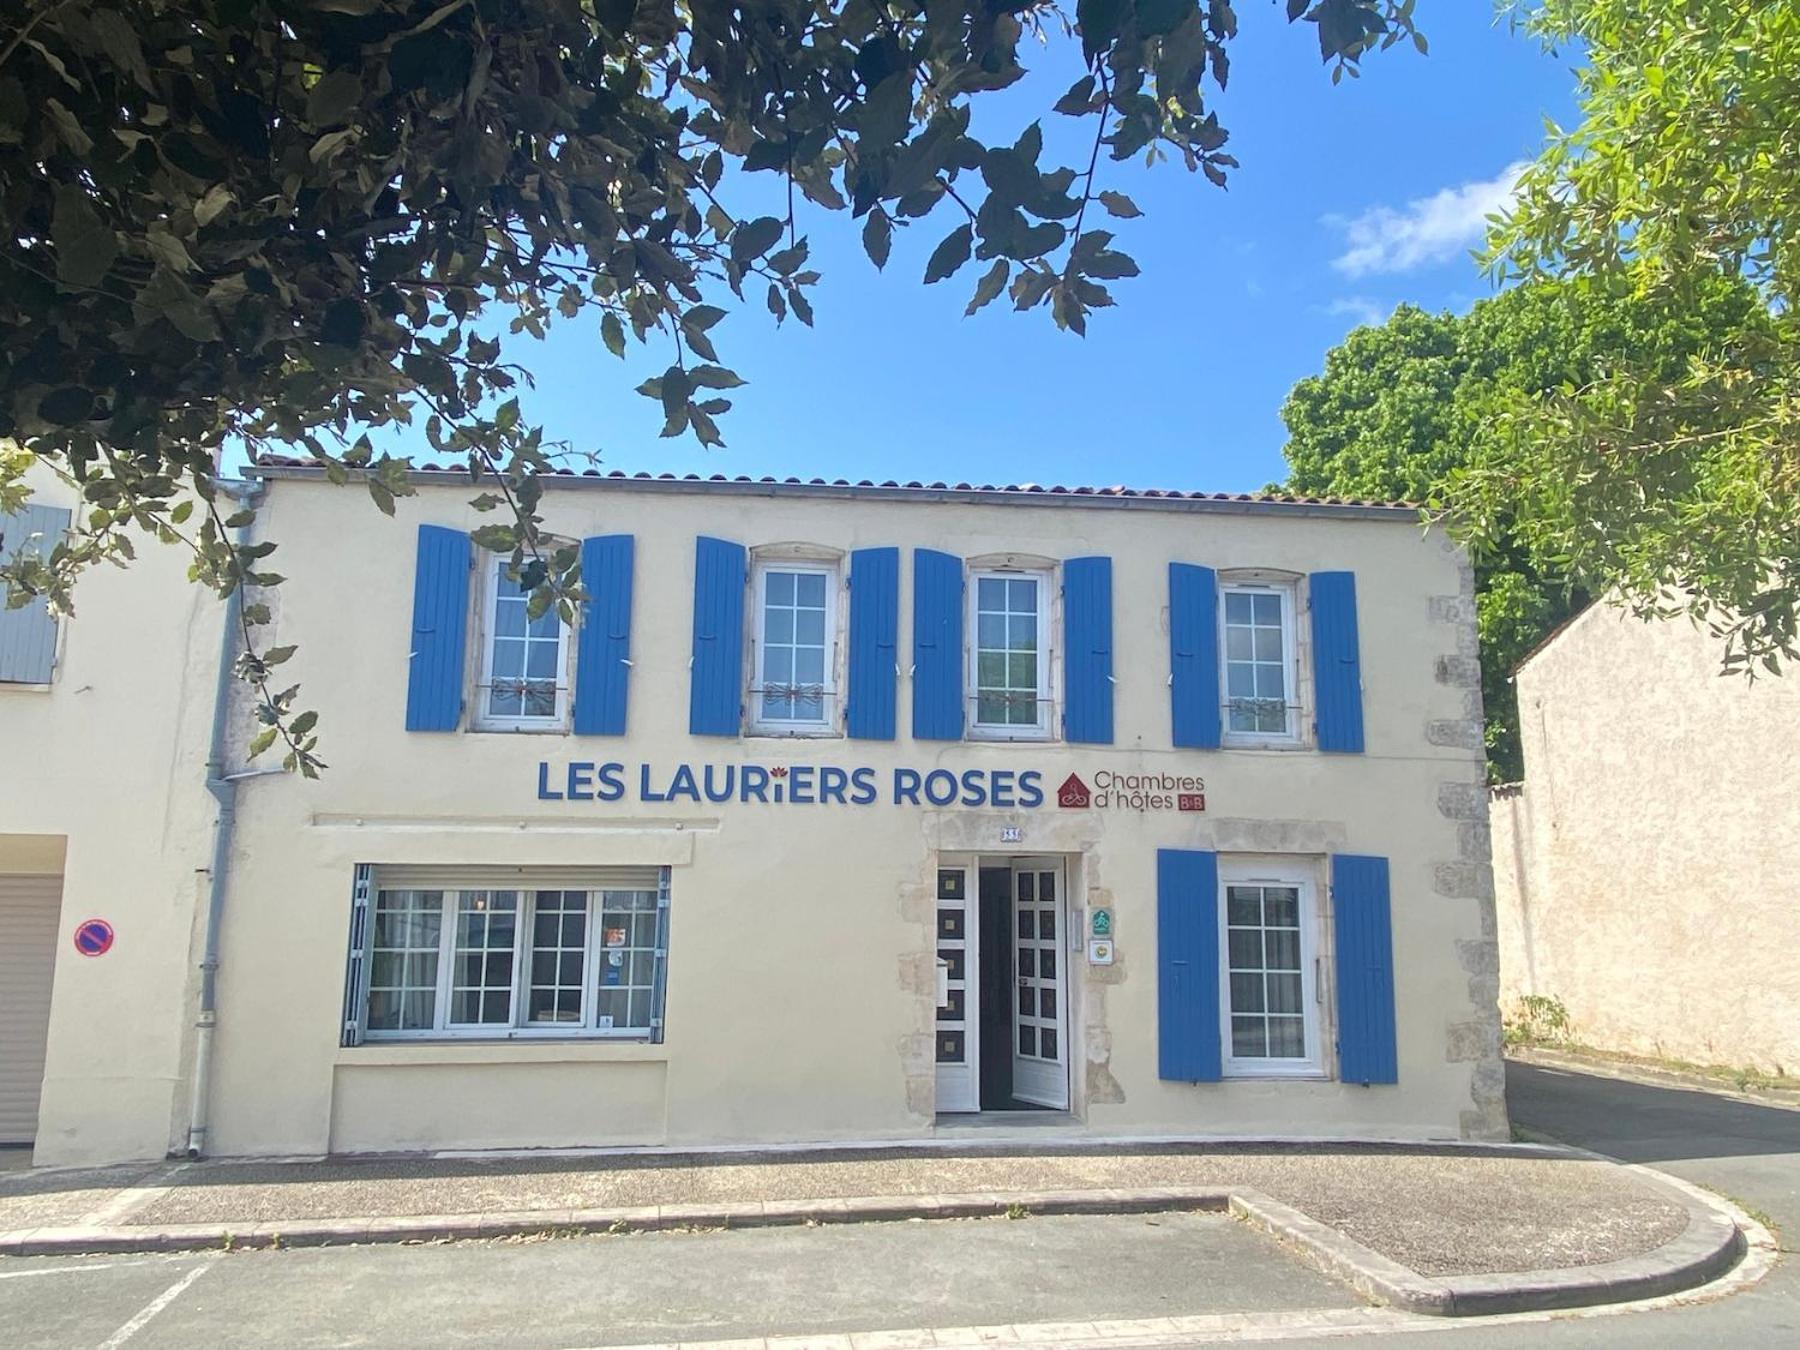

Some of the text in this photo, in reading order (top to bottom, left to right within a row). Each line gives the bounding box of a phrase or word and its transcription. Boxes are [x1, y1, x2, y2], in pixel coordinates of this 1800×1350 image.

[538, 762, 625, 800] LES
[894, 768, 1044, 808] ROSES
[1094, 770, 1205, 791] Chambres
[1094, 790, 1174, 809] d'hôtes
